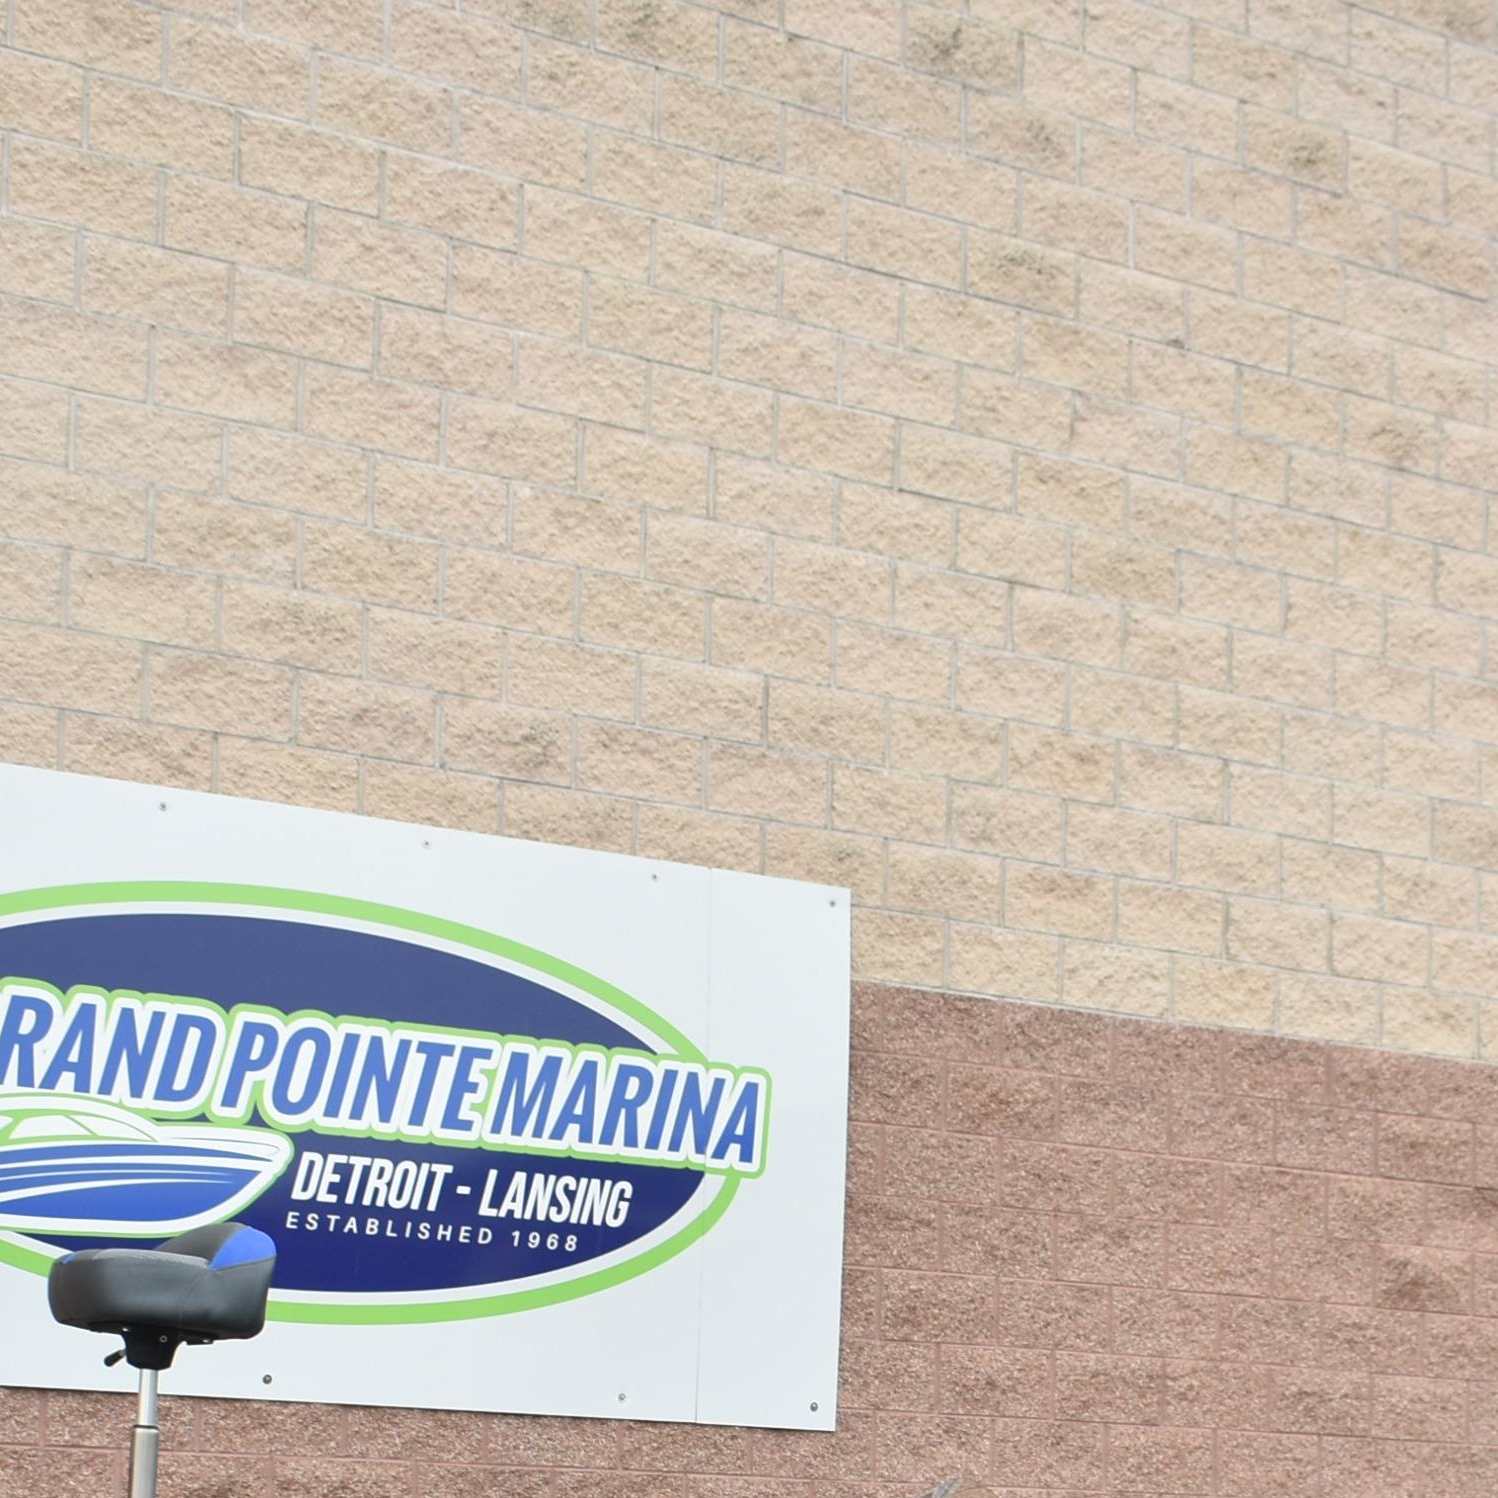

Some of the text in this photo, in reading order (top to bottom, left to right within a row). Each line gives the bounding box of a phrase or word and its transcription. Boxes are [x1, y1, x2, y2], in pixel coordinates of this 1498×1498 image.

[219, 1020, 493, 1133] POINTE
[490, 1051, 761, 1164] MARINA
[290, 1151, 454, 1212] DETROIT
[478, 1168, 633, 1228] LANSING
[285, 1211, 578, 1252] ESTABLISHED 1968
